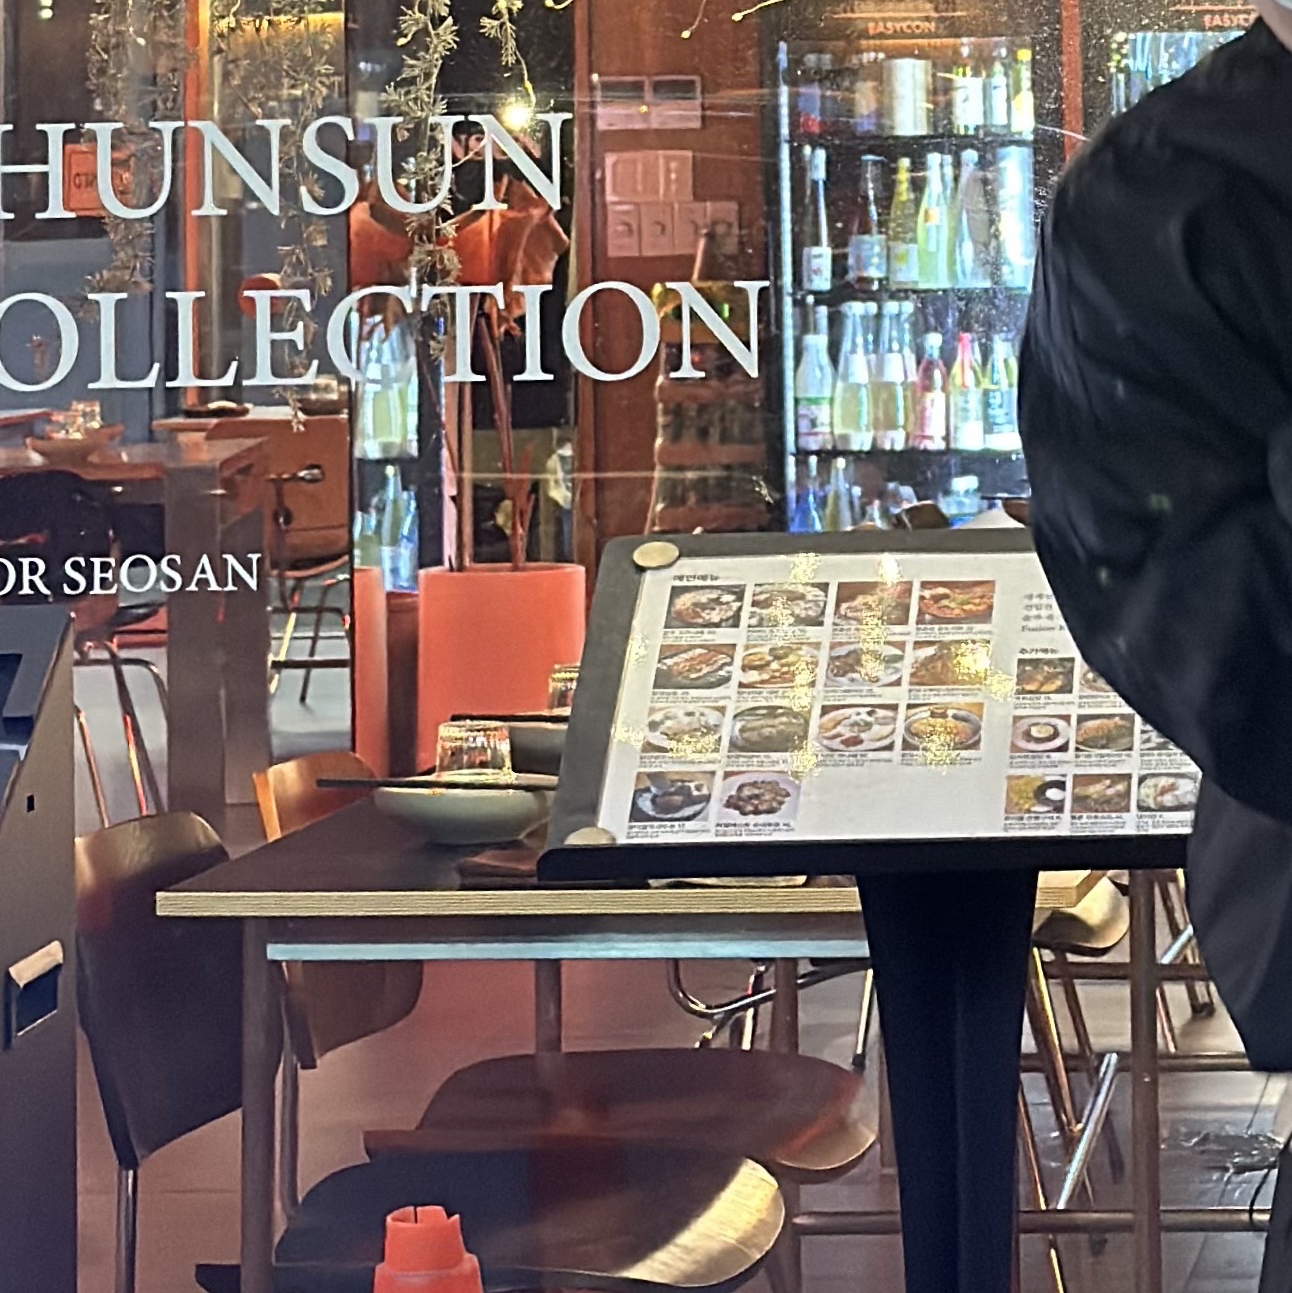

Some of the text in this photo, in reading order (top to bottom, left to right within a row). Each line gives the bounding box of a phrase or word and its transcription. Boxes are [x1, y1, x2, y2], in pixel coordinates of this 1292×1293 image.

[0, 112, 572, 221] HUNSUN
[0, 280, 770, 393] OLLECTION
[62, 553, 262, 596] SEOSAN
